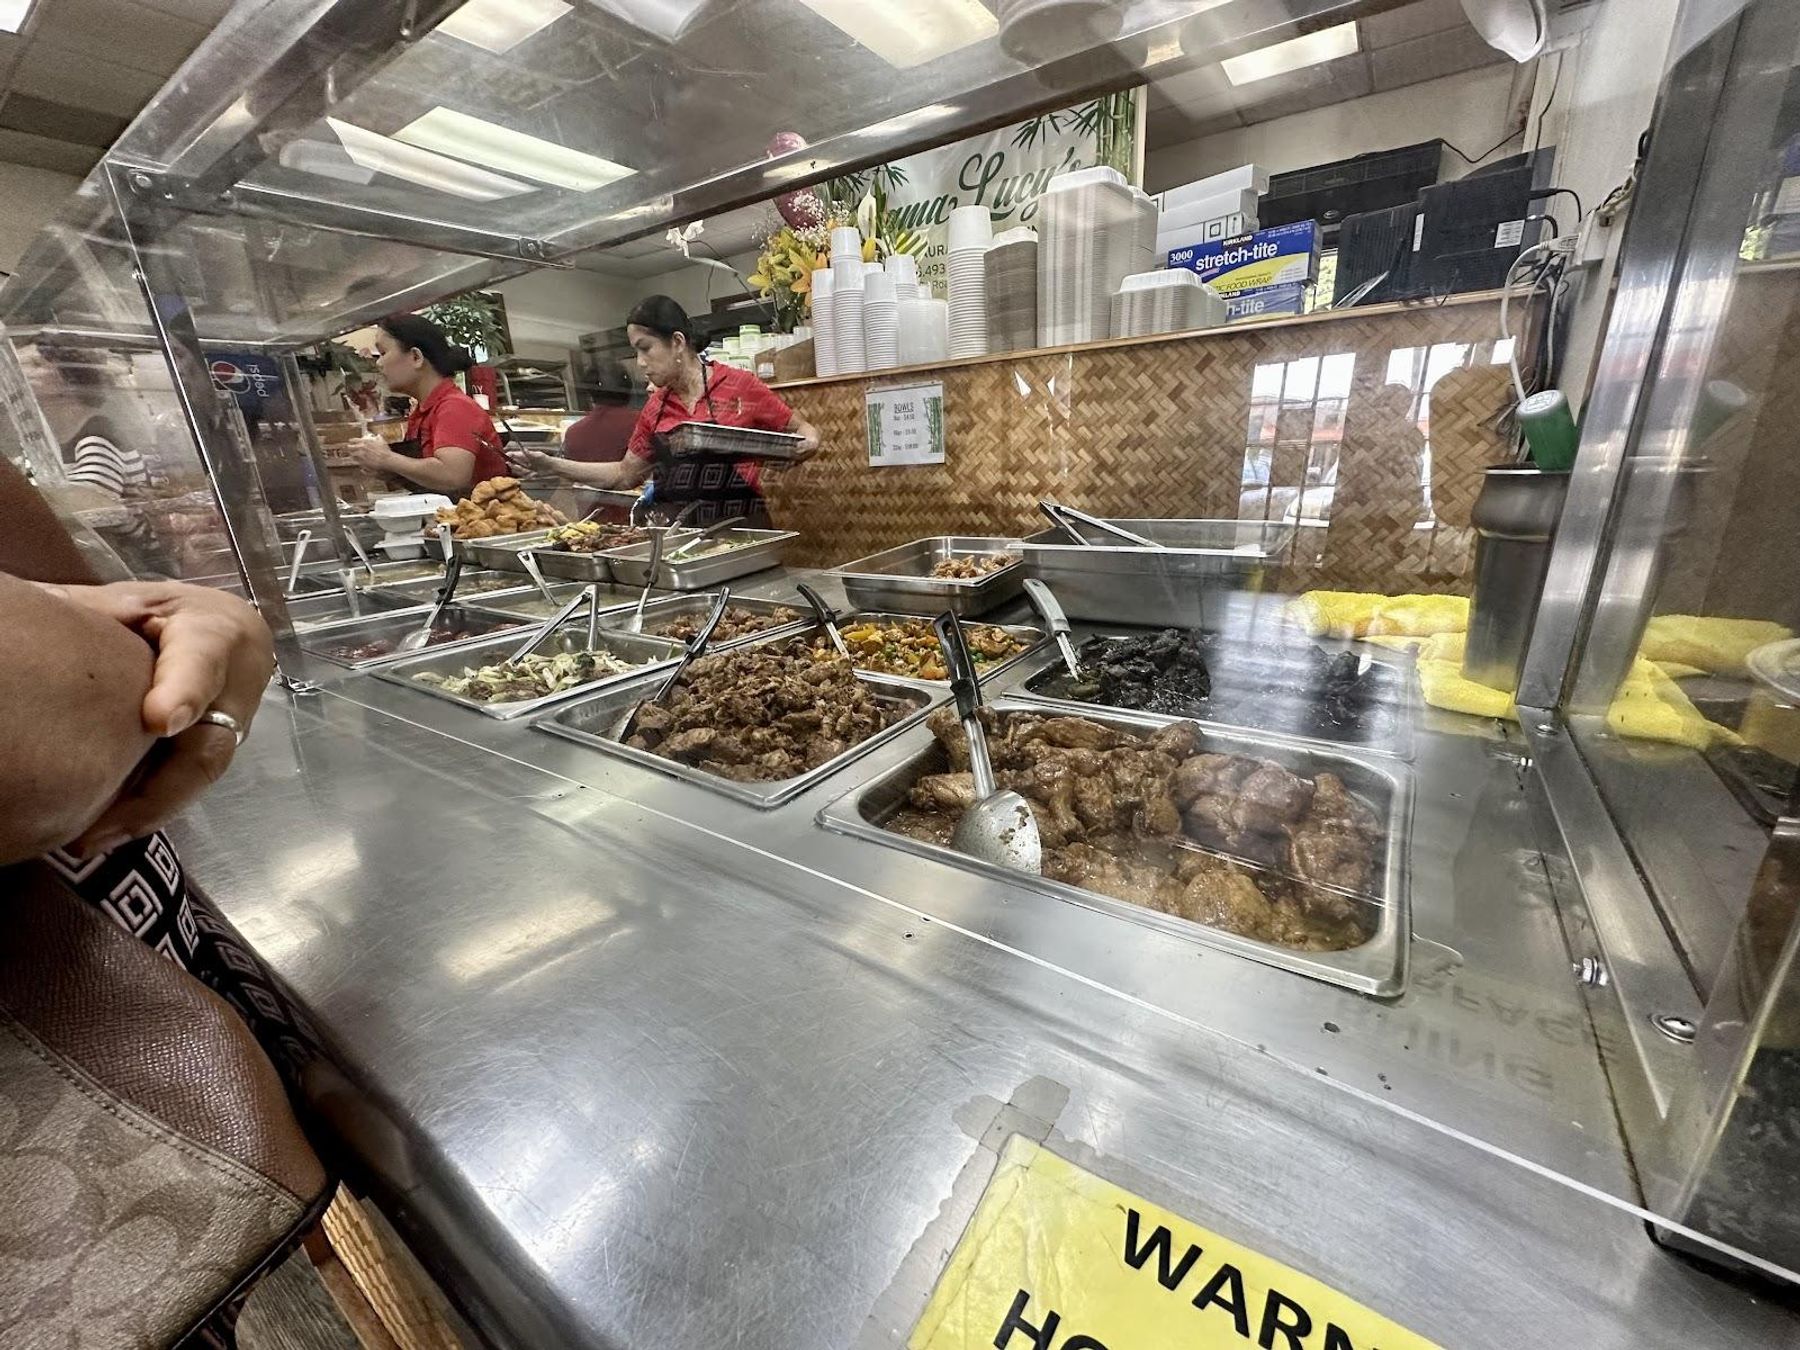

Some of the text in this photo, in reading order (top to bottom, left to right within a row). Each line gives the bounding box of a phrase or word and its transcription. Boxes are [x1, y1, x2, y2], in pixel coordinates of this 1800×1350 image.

[1222, 235, 1253, 247] KIRKLAND
[1170, 250, 1194, 261] 3000
[1195, 242, 1279, 271] stretch-tite
[1227, 280, 1247, 290] FOOD
[1248, 276, 1273, 287] WRAP
